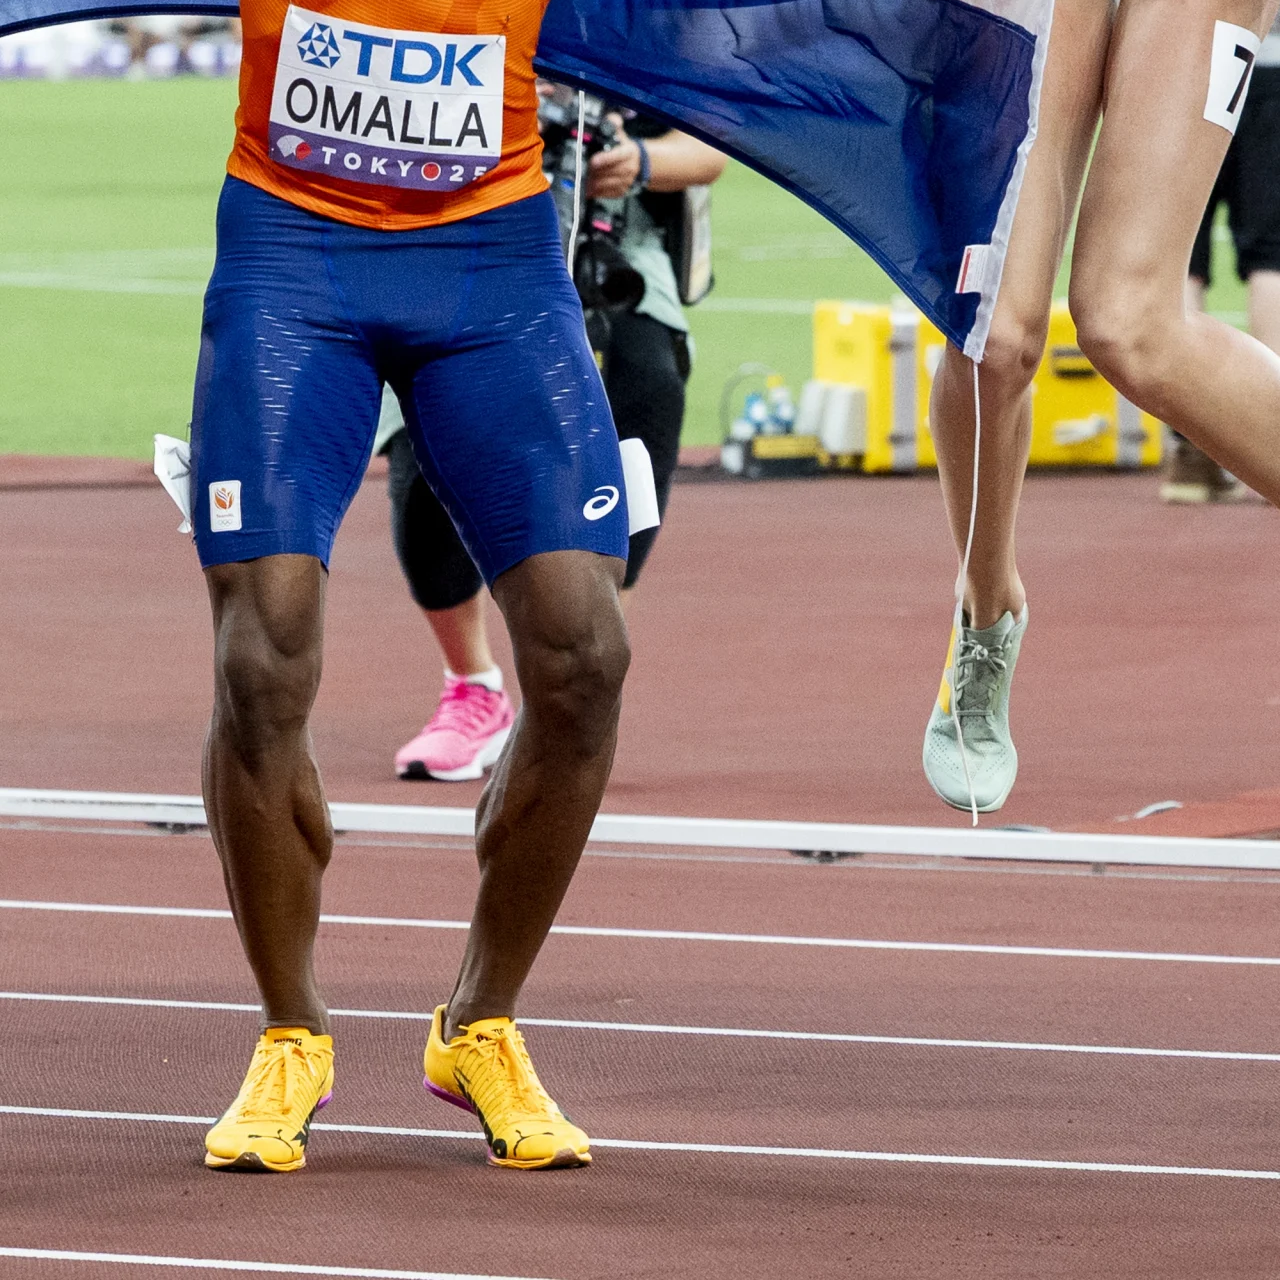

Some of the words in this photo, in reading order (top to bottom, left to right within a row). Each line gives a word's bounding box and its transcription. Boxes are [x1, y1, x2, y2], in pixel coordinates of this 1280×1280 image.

[343, 30, 488, 87] TDK
[1226, 43, 1255, 115] 7
[286, 77, 488, 148] OMALLA
